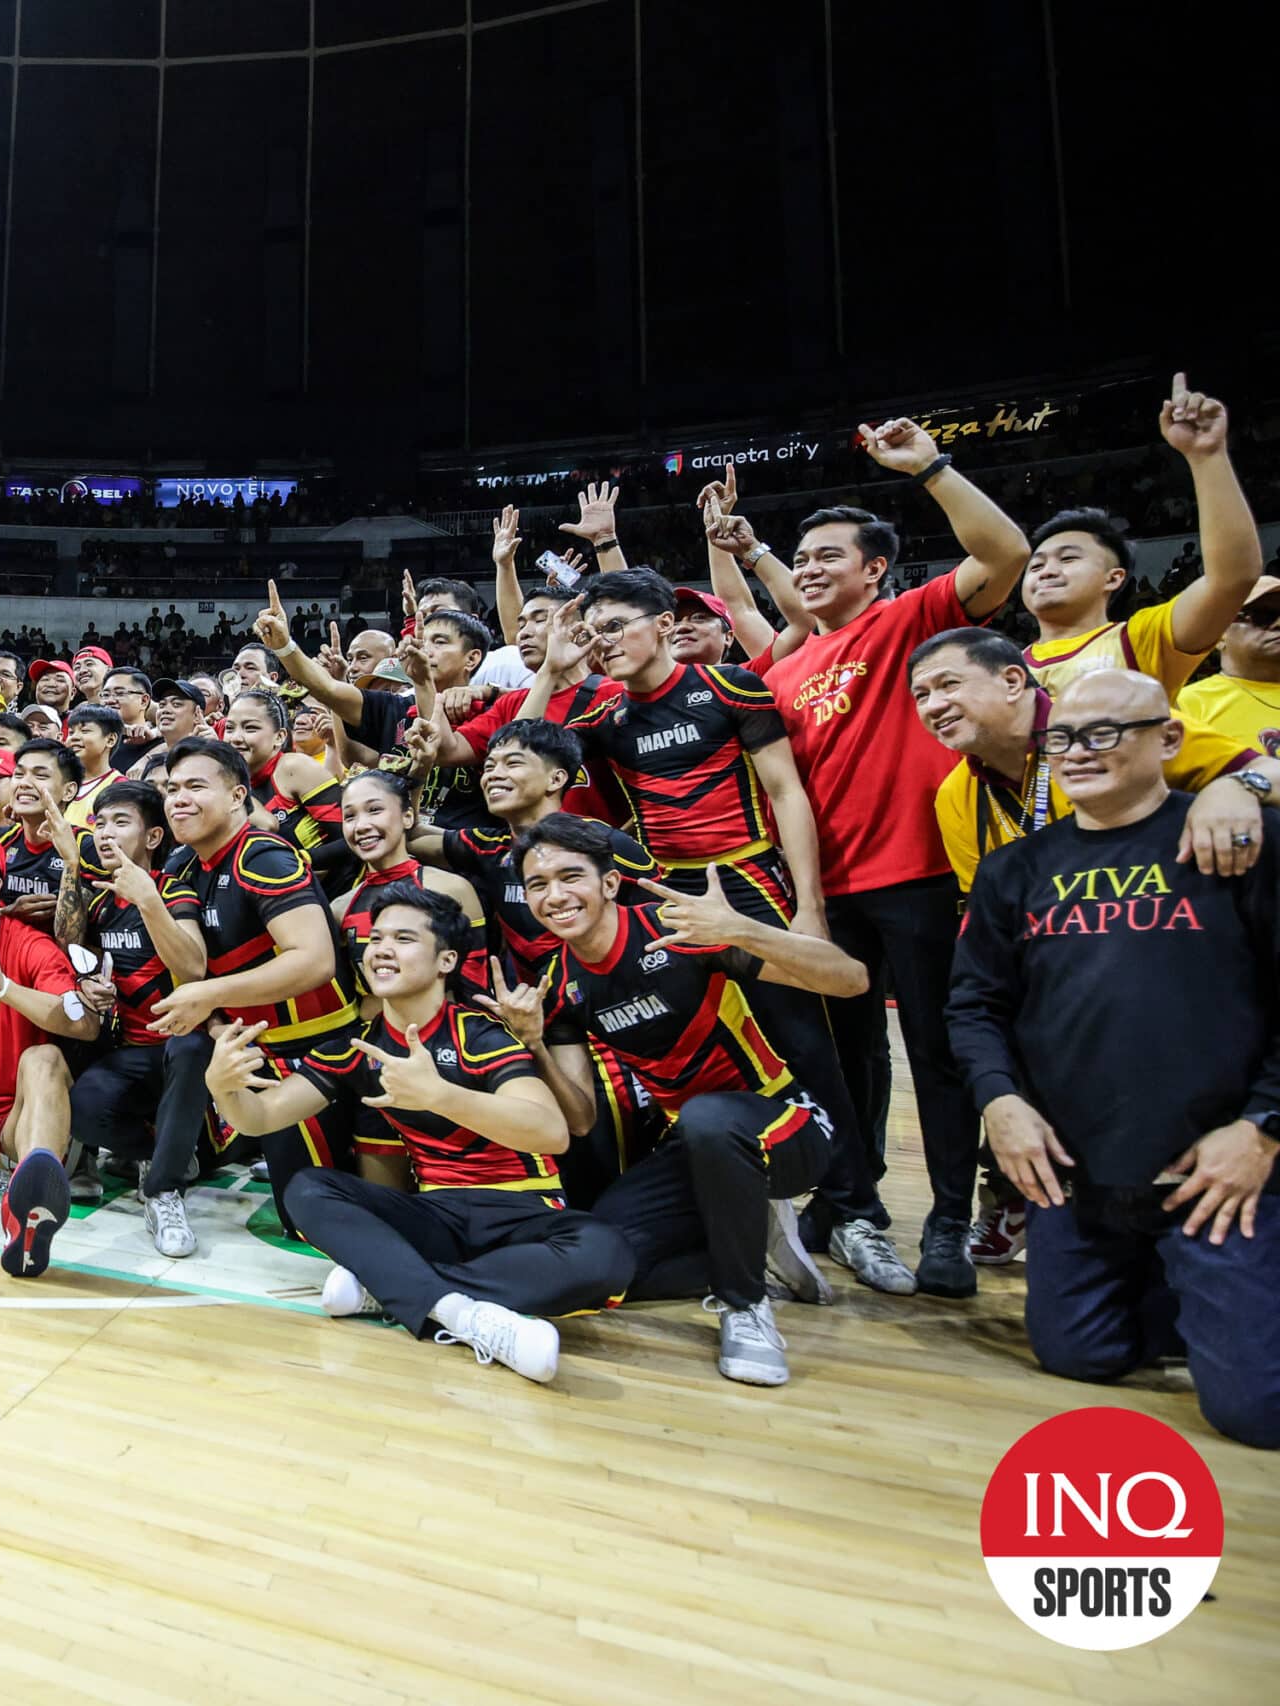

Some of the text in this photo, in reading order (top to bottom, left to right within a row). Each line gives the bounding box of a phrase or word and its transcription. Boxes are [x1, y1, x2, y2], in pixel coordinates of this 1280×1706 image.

[986, 403, 1061, 437] Hut
[692, 448, 769, 468] araneta
[905, 566, 927, 579] 207
[636, 722, 701, 754] MAPÚA
[7, 875, 50, 896] MAPÚA
[1052, 864, 1172, 901] VIVA
[1024, 894, 1204, 940] MAPÚA
[100, 928, 141, 949] MAPÚA
[598, 996, 669, 1033] MAPÚA
